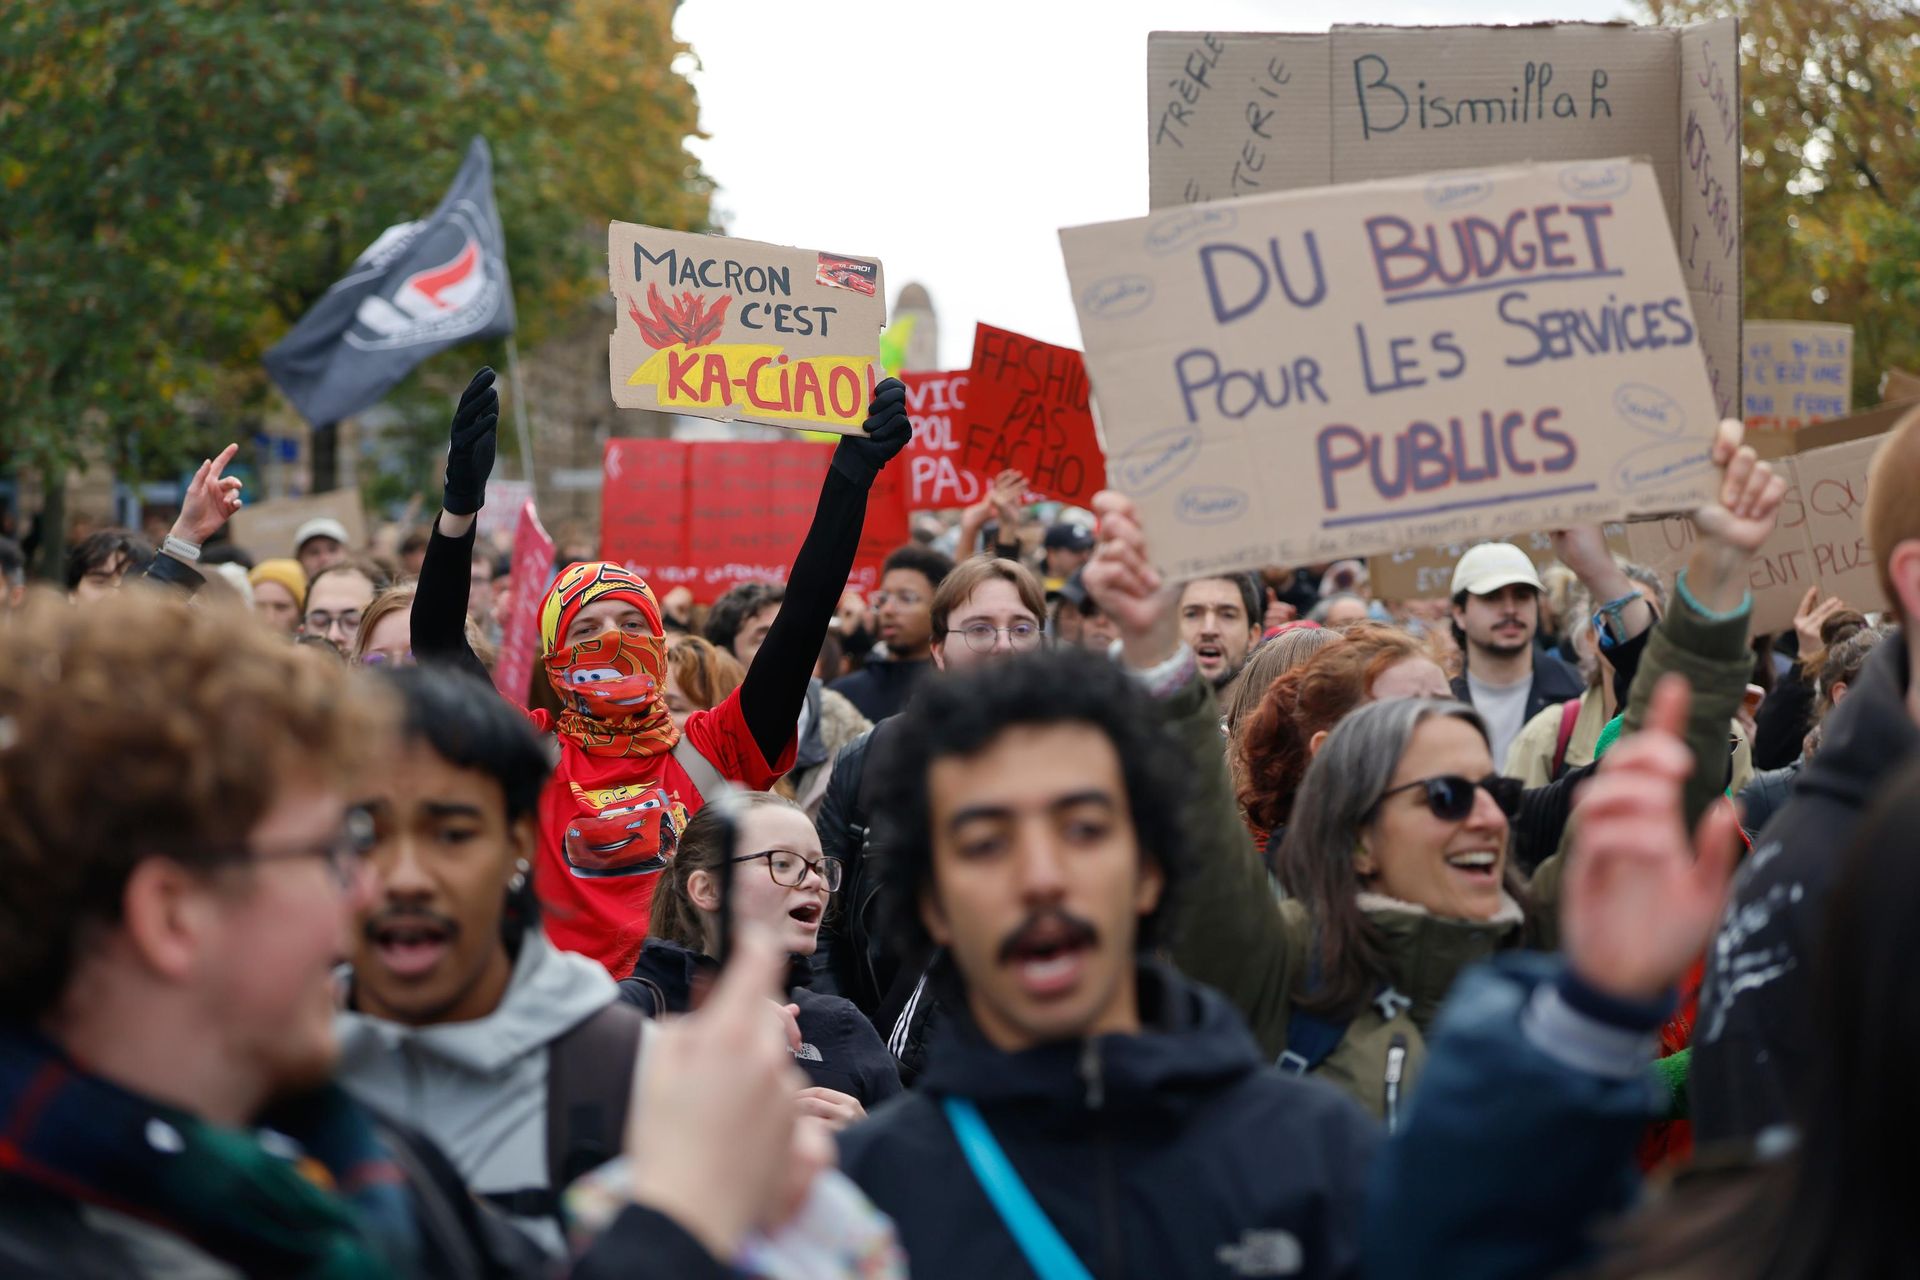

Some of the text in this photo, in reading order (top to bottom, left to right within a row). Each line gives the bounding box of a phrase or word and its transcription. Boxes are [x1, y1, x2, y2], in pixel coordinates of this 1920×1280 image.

[1231, 56, 1292, 198] TERIE
[1353, 54, 1612, 140] Bismillah
[632, 241, 791, 297] MACRON
[1199, 203, 1613, 325] DU BUDGET
[740, 302, 838, 338] C'EST
[1173, 292, 1695, 424] POUR LES SERVICES
[977, 331, 1091, 412] FASHIO
[961, 423, 1085, 498] FACHO
[1003, 396, 1068, 450] PAS
[1315, 408, 1578, 513] PUBLICS
[558, 562, 646, 609] 95
[1750, 551, 1804, 591] ENT
